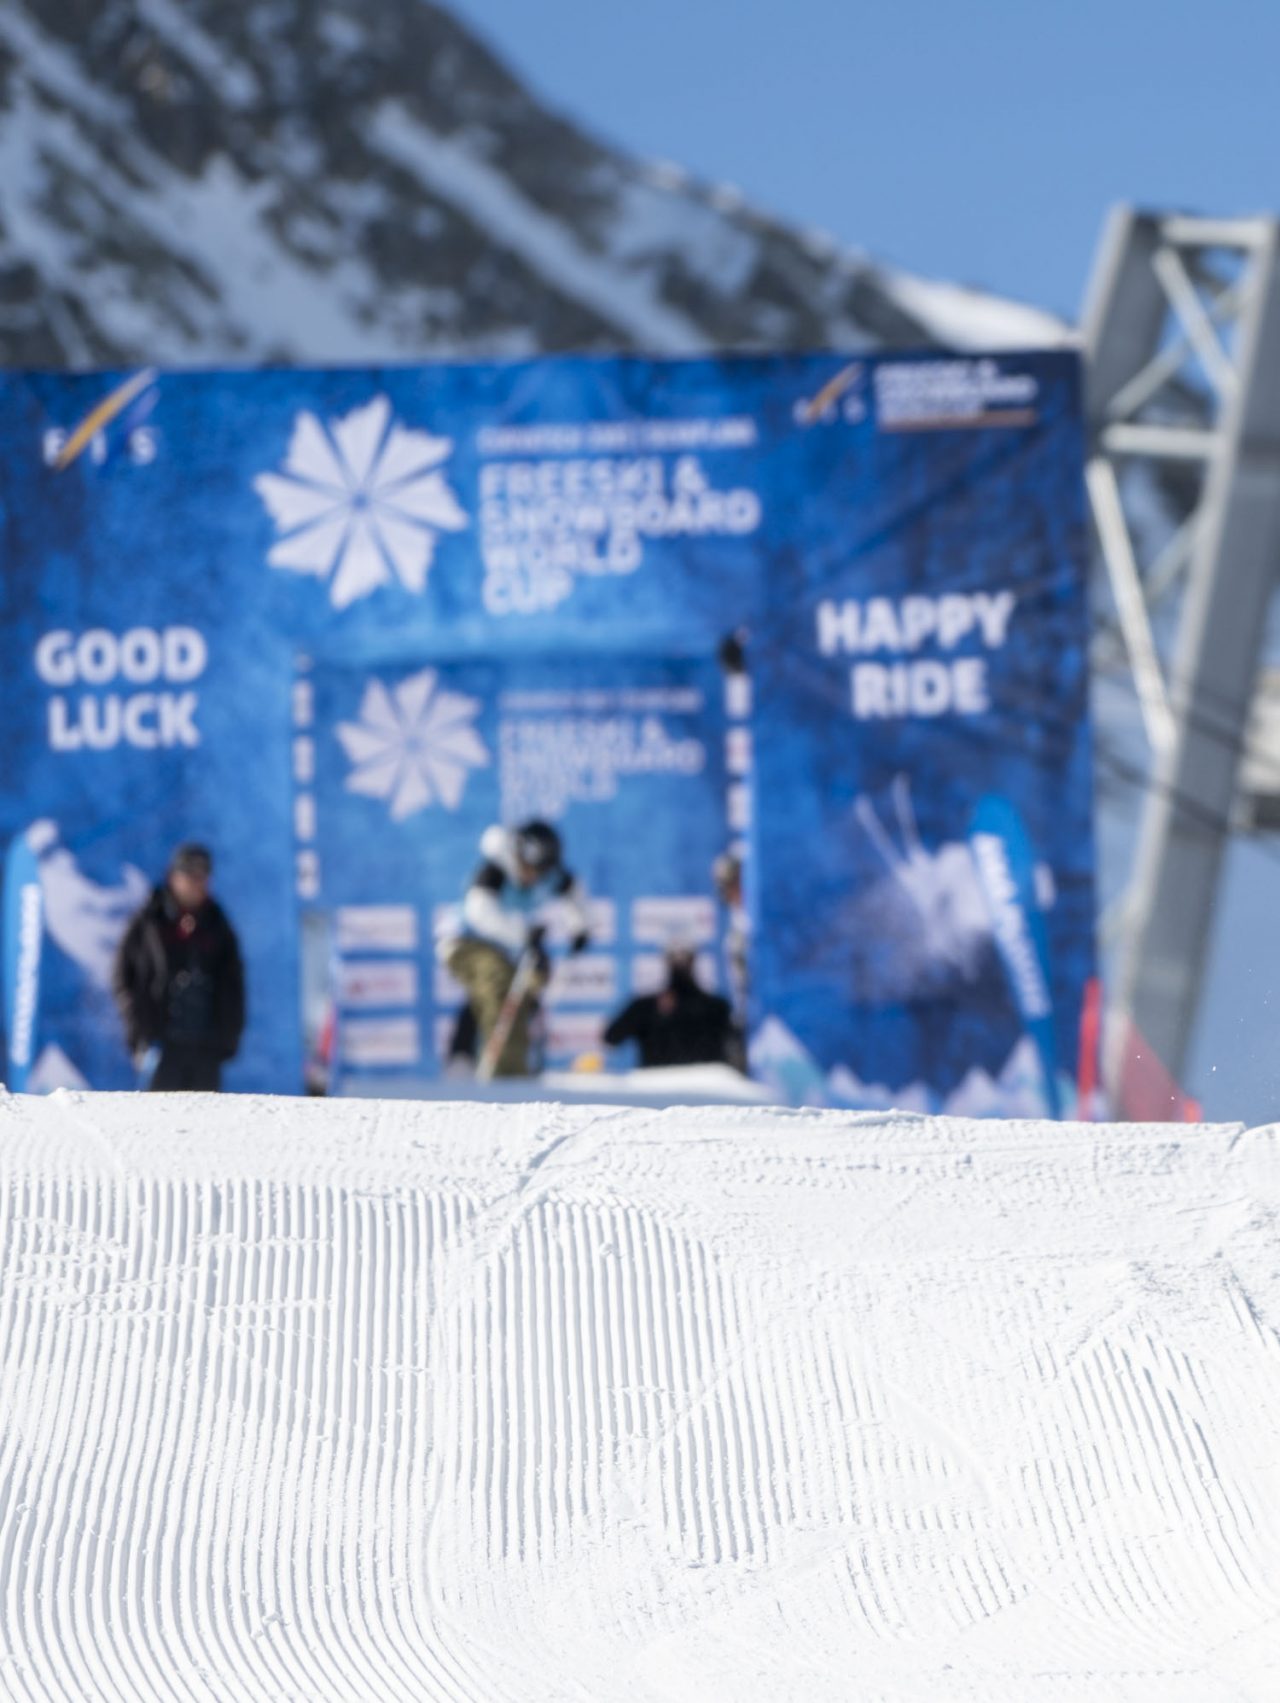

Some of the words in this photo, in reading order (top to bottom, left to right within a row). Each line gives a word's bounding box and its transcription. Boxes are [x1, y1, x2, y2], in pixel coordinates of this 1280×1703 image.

[817, 589, 1014, 656] HAPPY
[36, 628, 206, 685] GOOD
[851, 657, 990, 719] RIDE
[49, 692, 199, 751] LUCK
